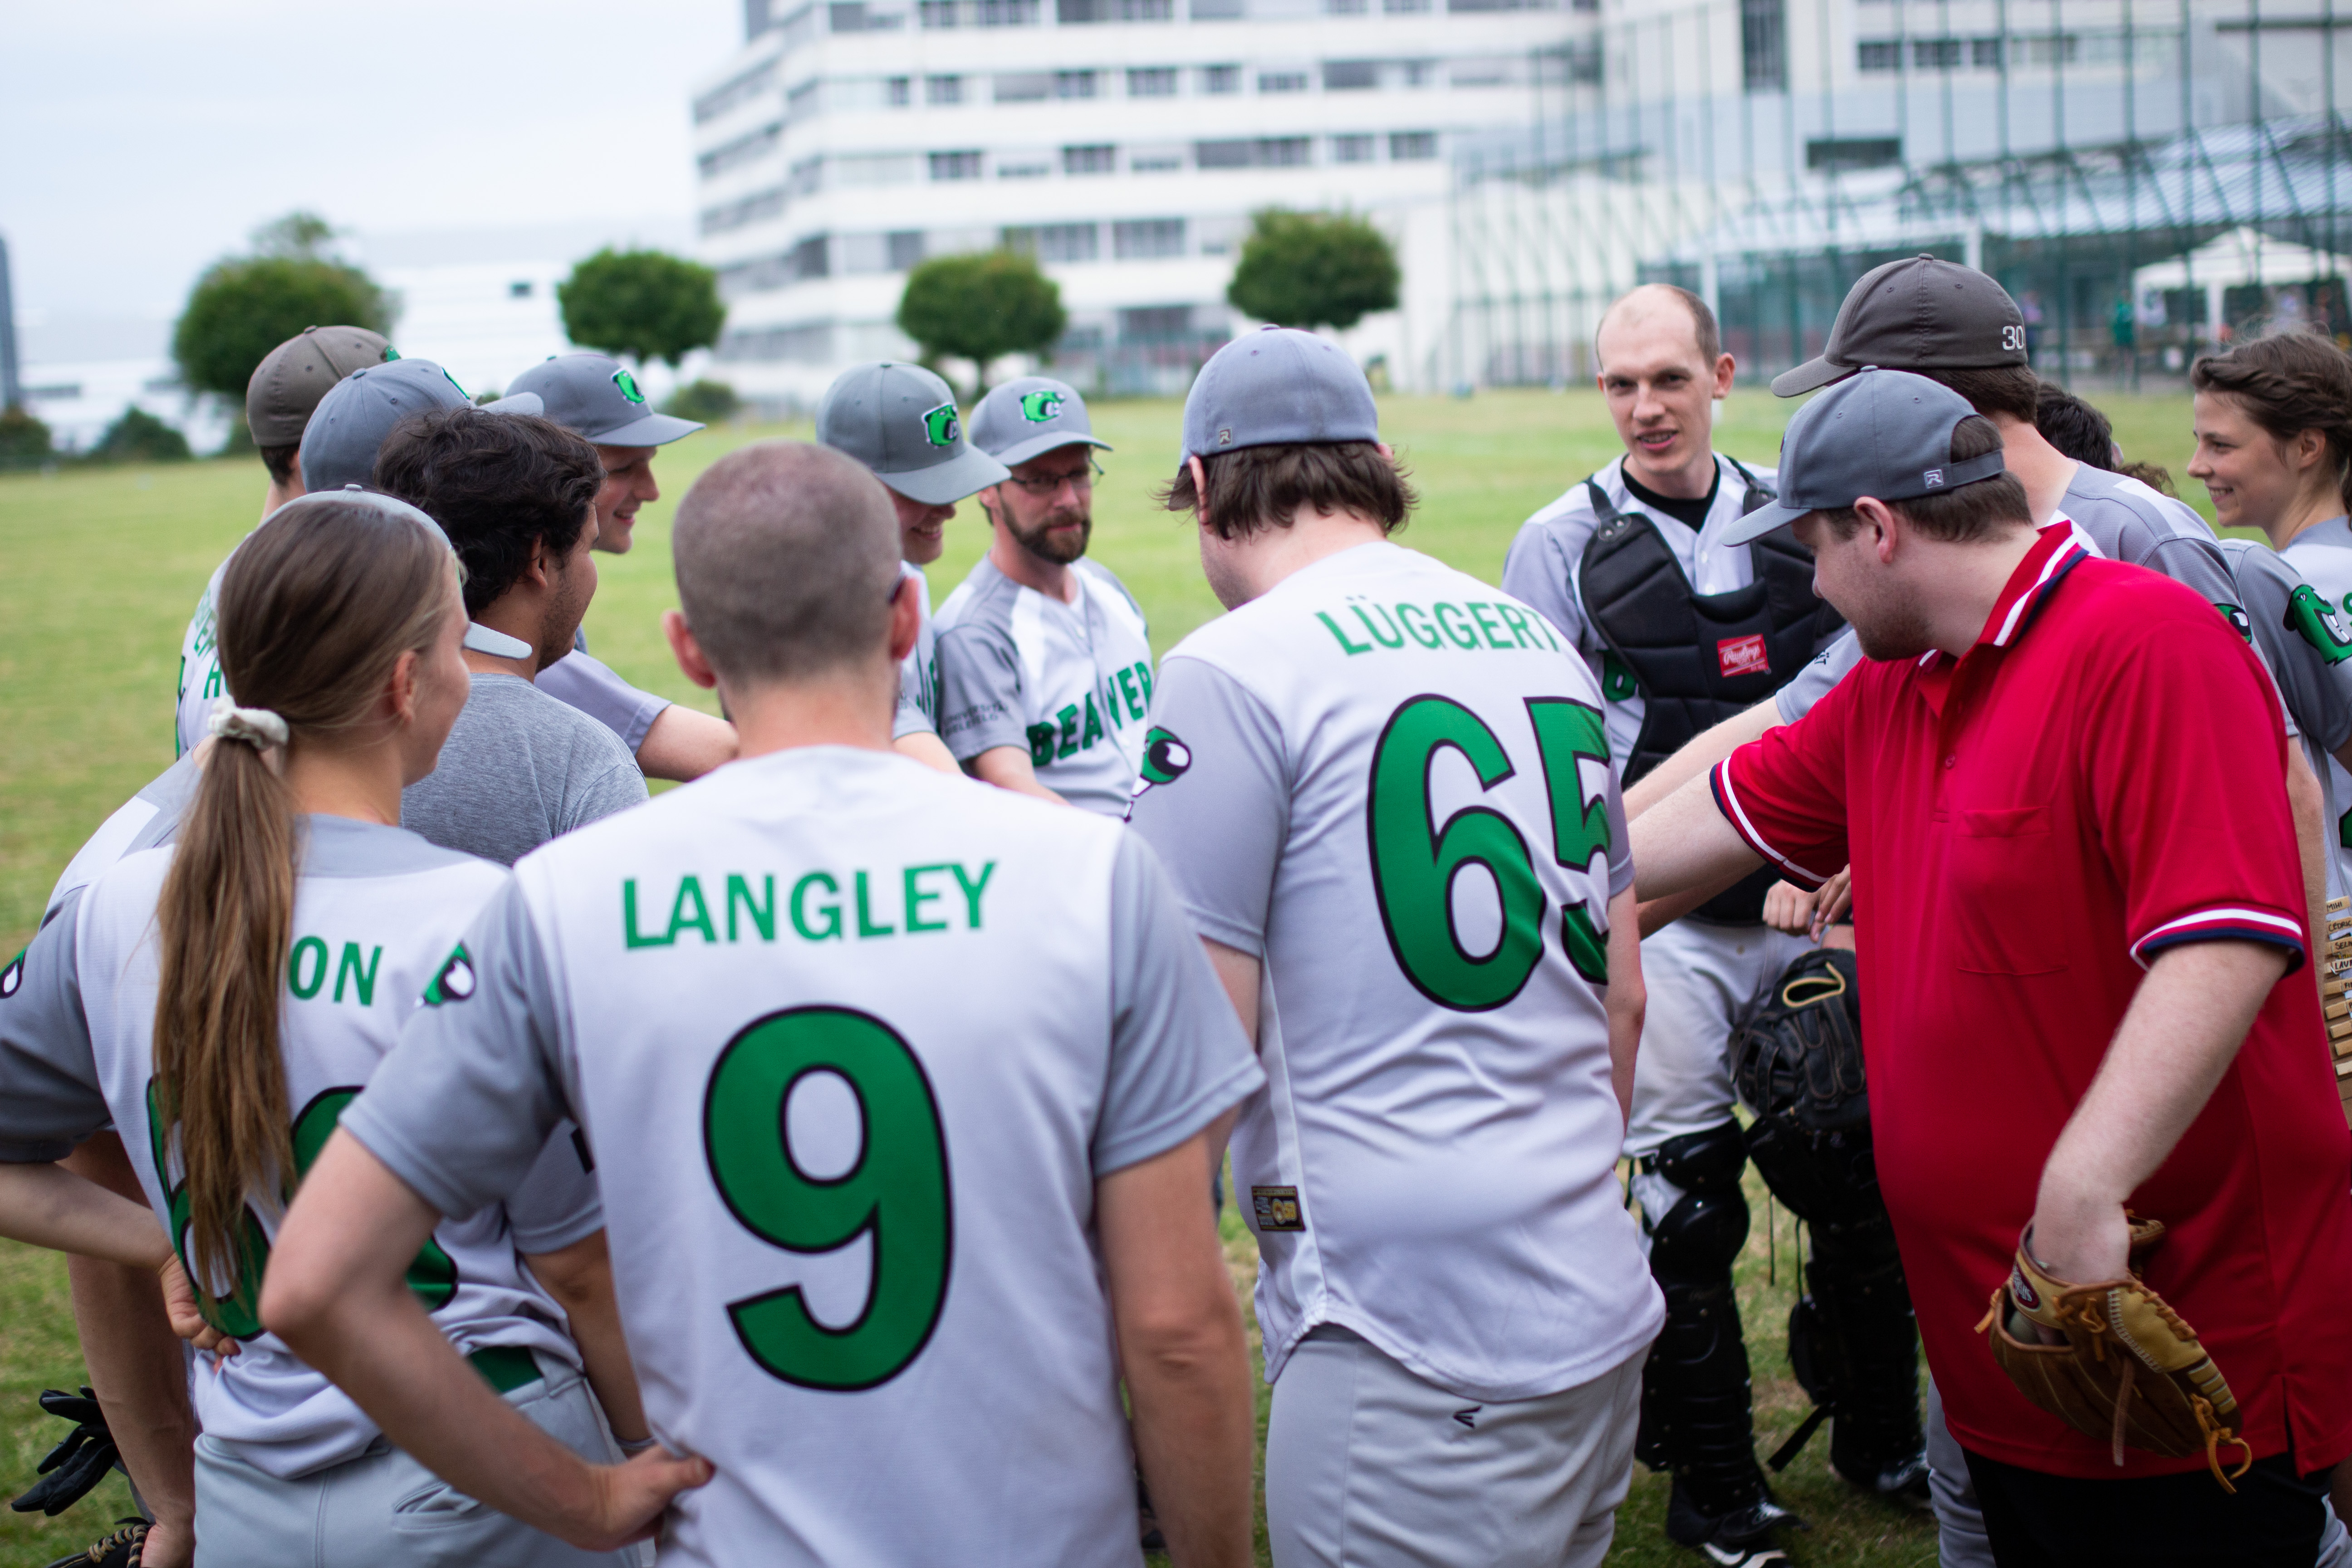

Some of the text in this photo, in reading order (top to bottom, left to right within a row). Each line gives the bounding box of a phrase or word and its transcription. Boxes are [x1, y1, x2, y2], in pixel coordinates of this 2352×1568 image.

[2002, 325, 2024, 351] 30
[1314, 595, 1560, 656] LÜGGERT
[1367, 693, 1611, 1014] 65
[623, 858, 997, 951] LANGLEY
[702, 1003, 954, 1393] 9
